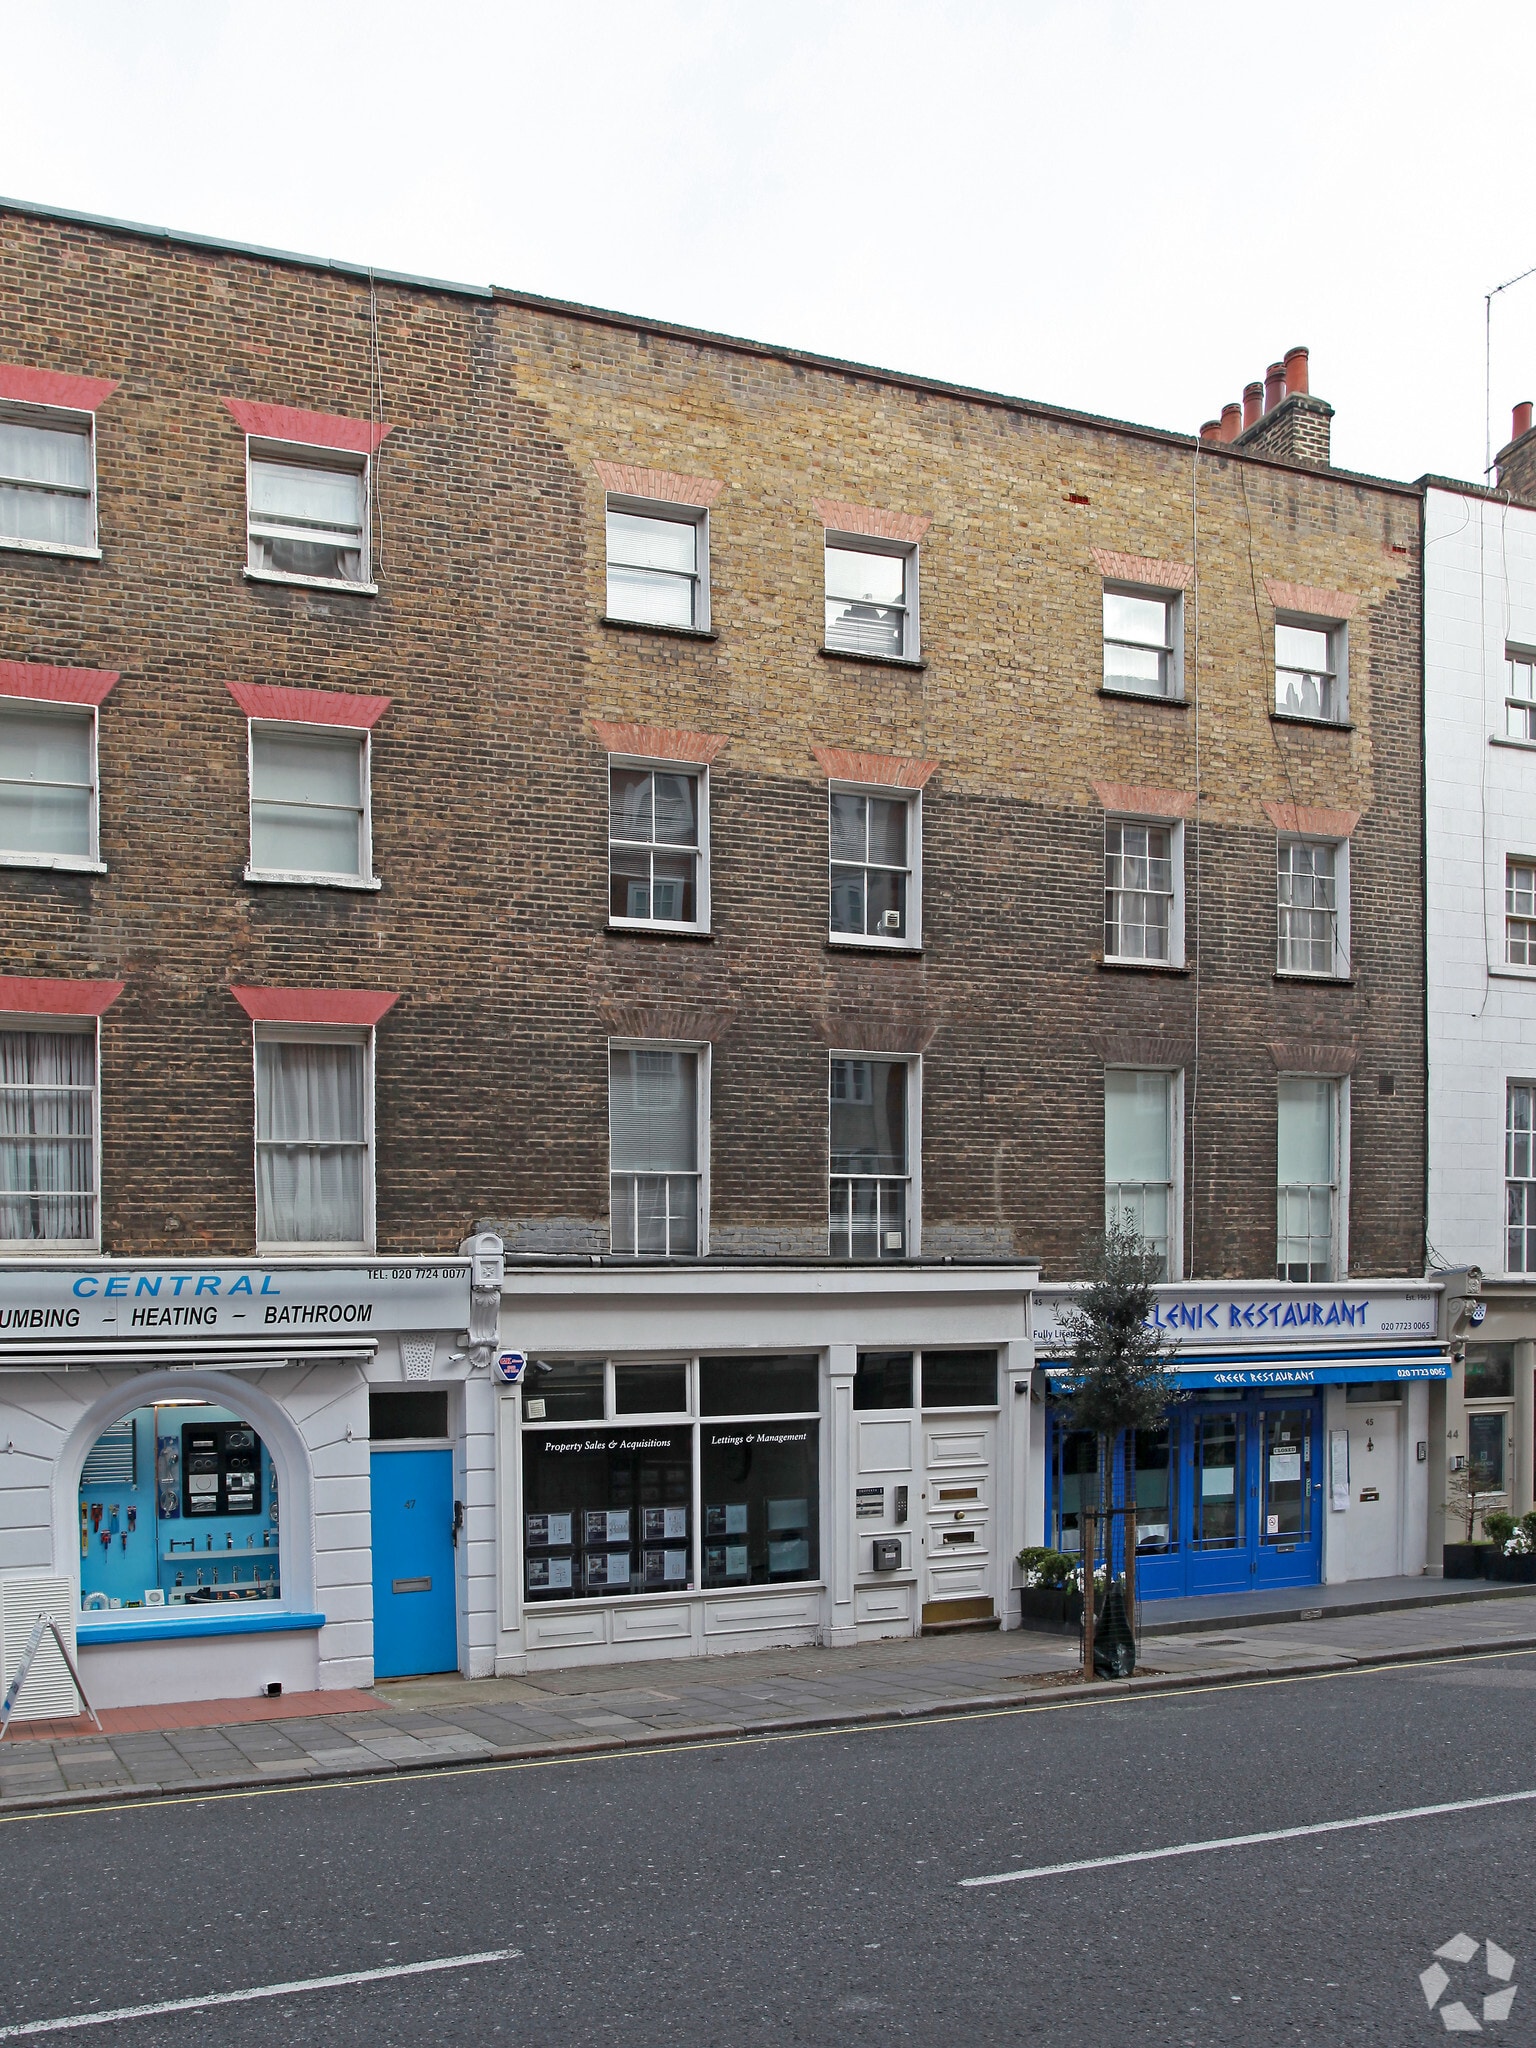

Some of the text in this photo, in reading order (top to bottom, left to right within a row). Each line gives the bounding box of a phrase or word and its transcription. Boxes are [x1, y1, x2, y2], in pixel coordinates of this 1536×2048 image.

[367, 1269, 466, 1280] TEL: 020 7724 0077
[72, 1275, 281, 1298] CENTRAL
[0, 1308, 80, 1328] UMBING
[131, 1306, 218, 1327] HEATING
[264, 1304, 373, 1324] BATHROOM
[1229, 1300, 1369, 1328] RESTAURANT
[1381, 1321, 1430, 1331] 020 7723 0065
[1033, 1330, 1053, 1341] Fully
[1214, 1370, 1315, 1383] GREEK RESTAURANT
[1397, 1369, 1410, 1377] 020
[1430, 1367, 1446, 1376] 0065
[1365, 1418, 1374, 1426] 45
[711, 1433, 807, 1445] Lettings & Management
[1447, 1430, 1459, 1439] 44
[545, 1438, 671, 1452] Property Sales & Acquisitions
[403, 1499, 416, 1509] 47
